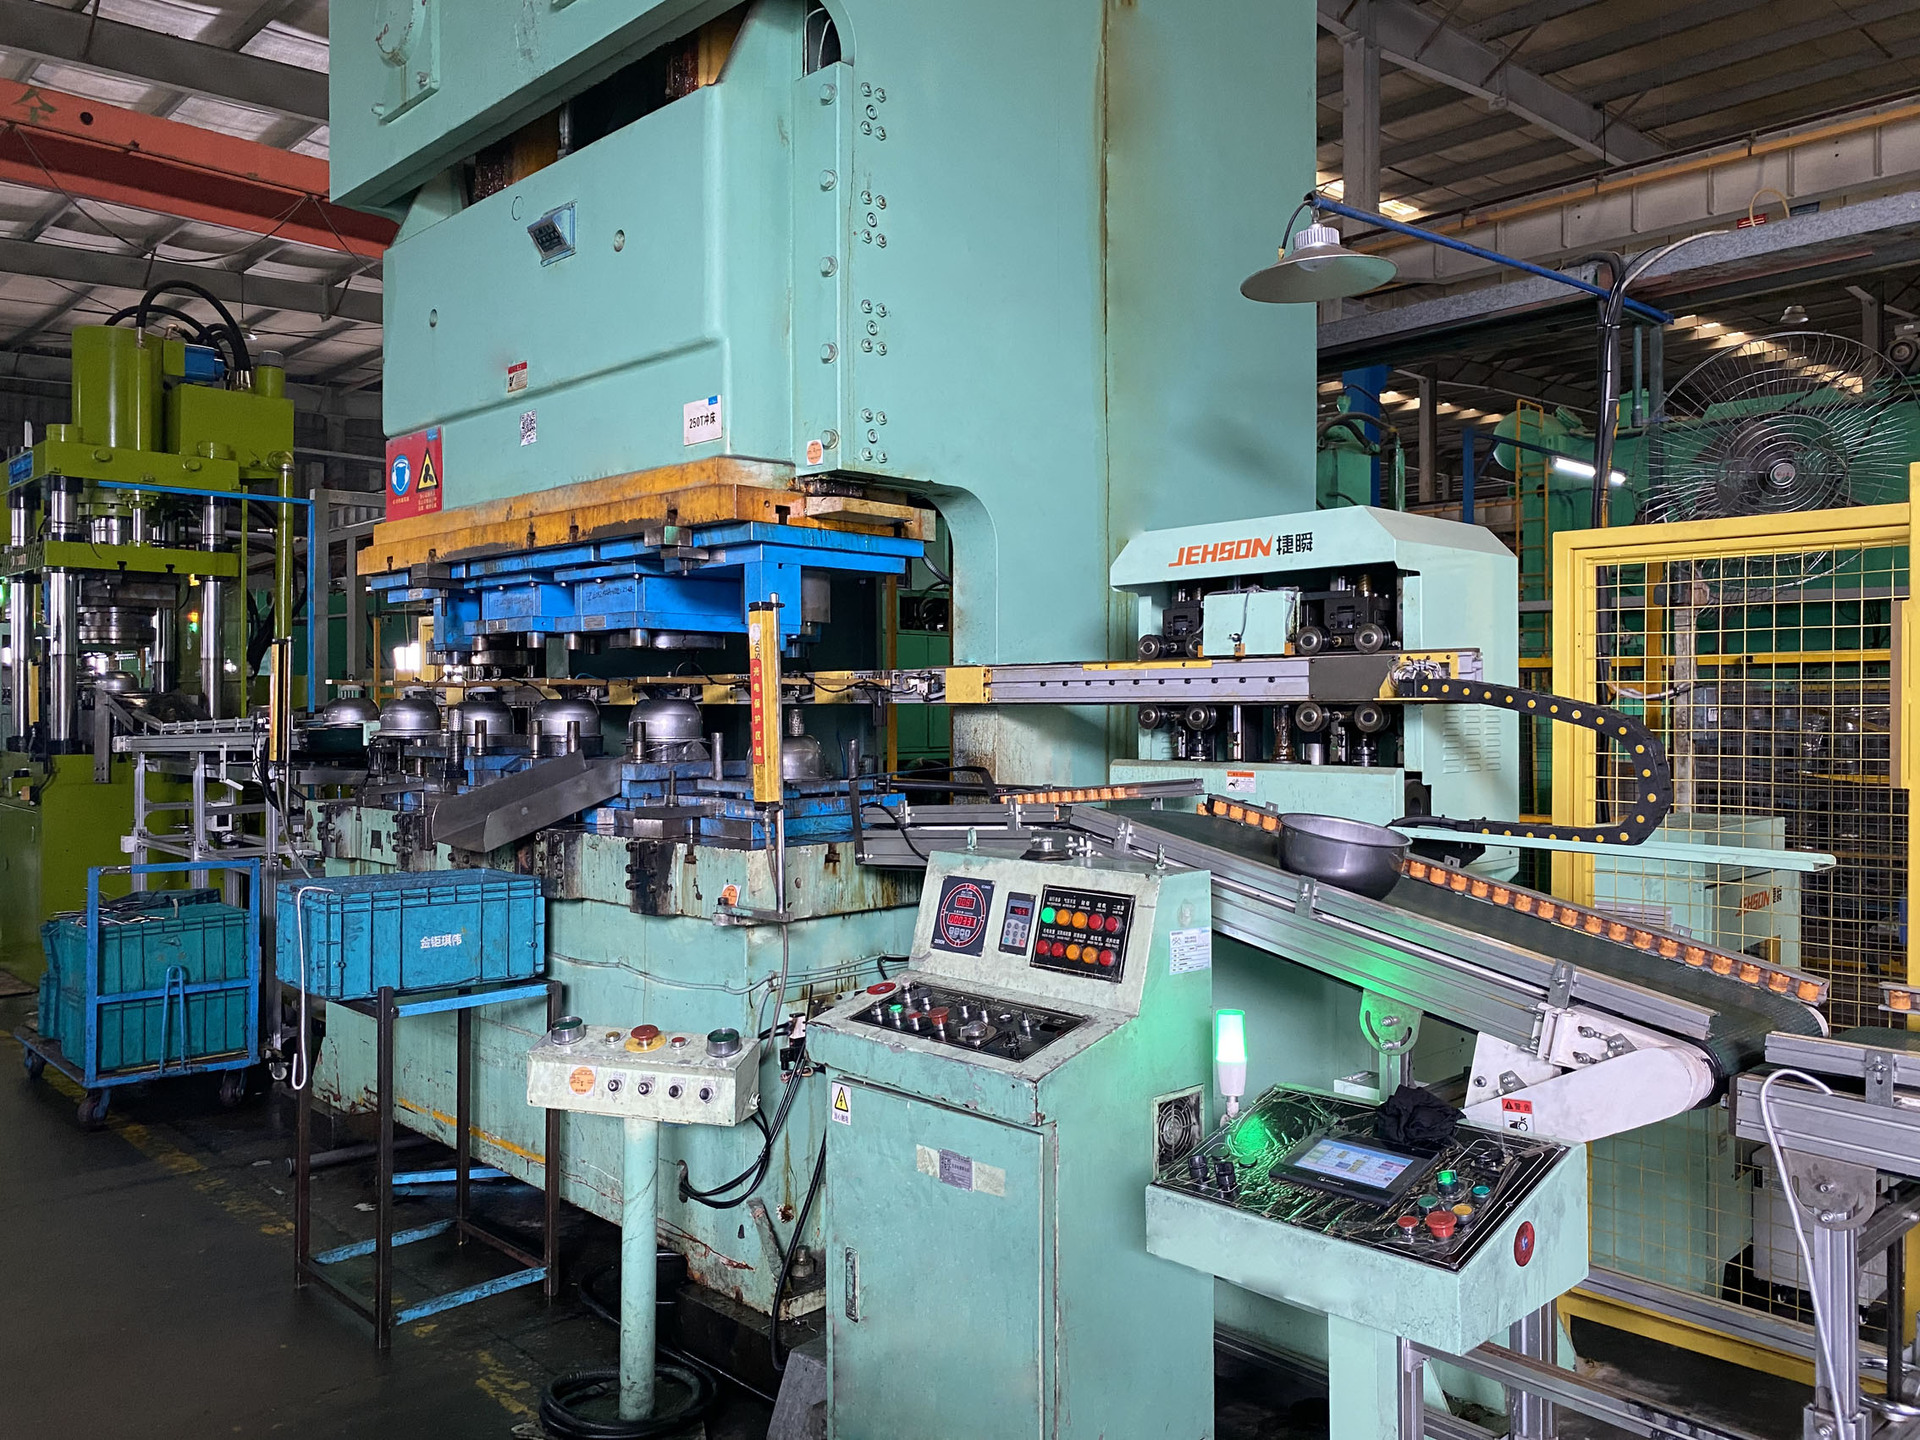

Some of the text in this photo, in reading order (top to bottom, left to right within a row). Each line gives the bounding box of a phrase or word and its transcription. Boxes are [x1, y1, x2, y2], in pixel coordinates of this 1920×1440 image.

[689, 411, 716, 429] 250T冲床
[1168, 532, 1313, 567] JEHSON 捷瞬
[753, 666, 762, 757] 光电保护区域
